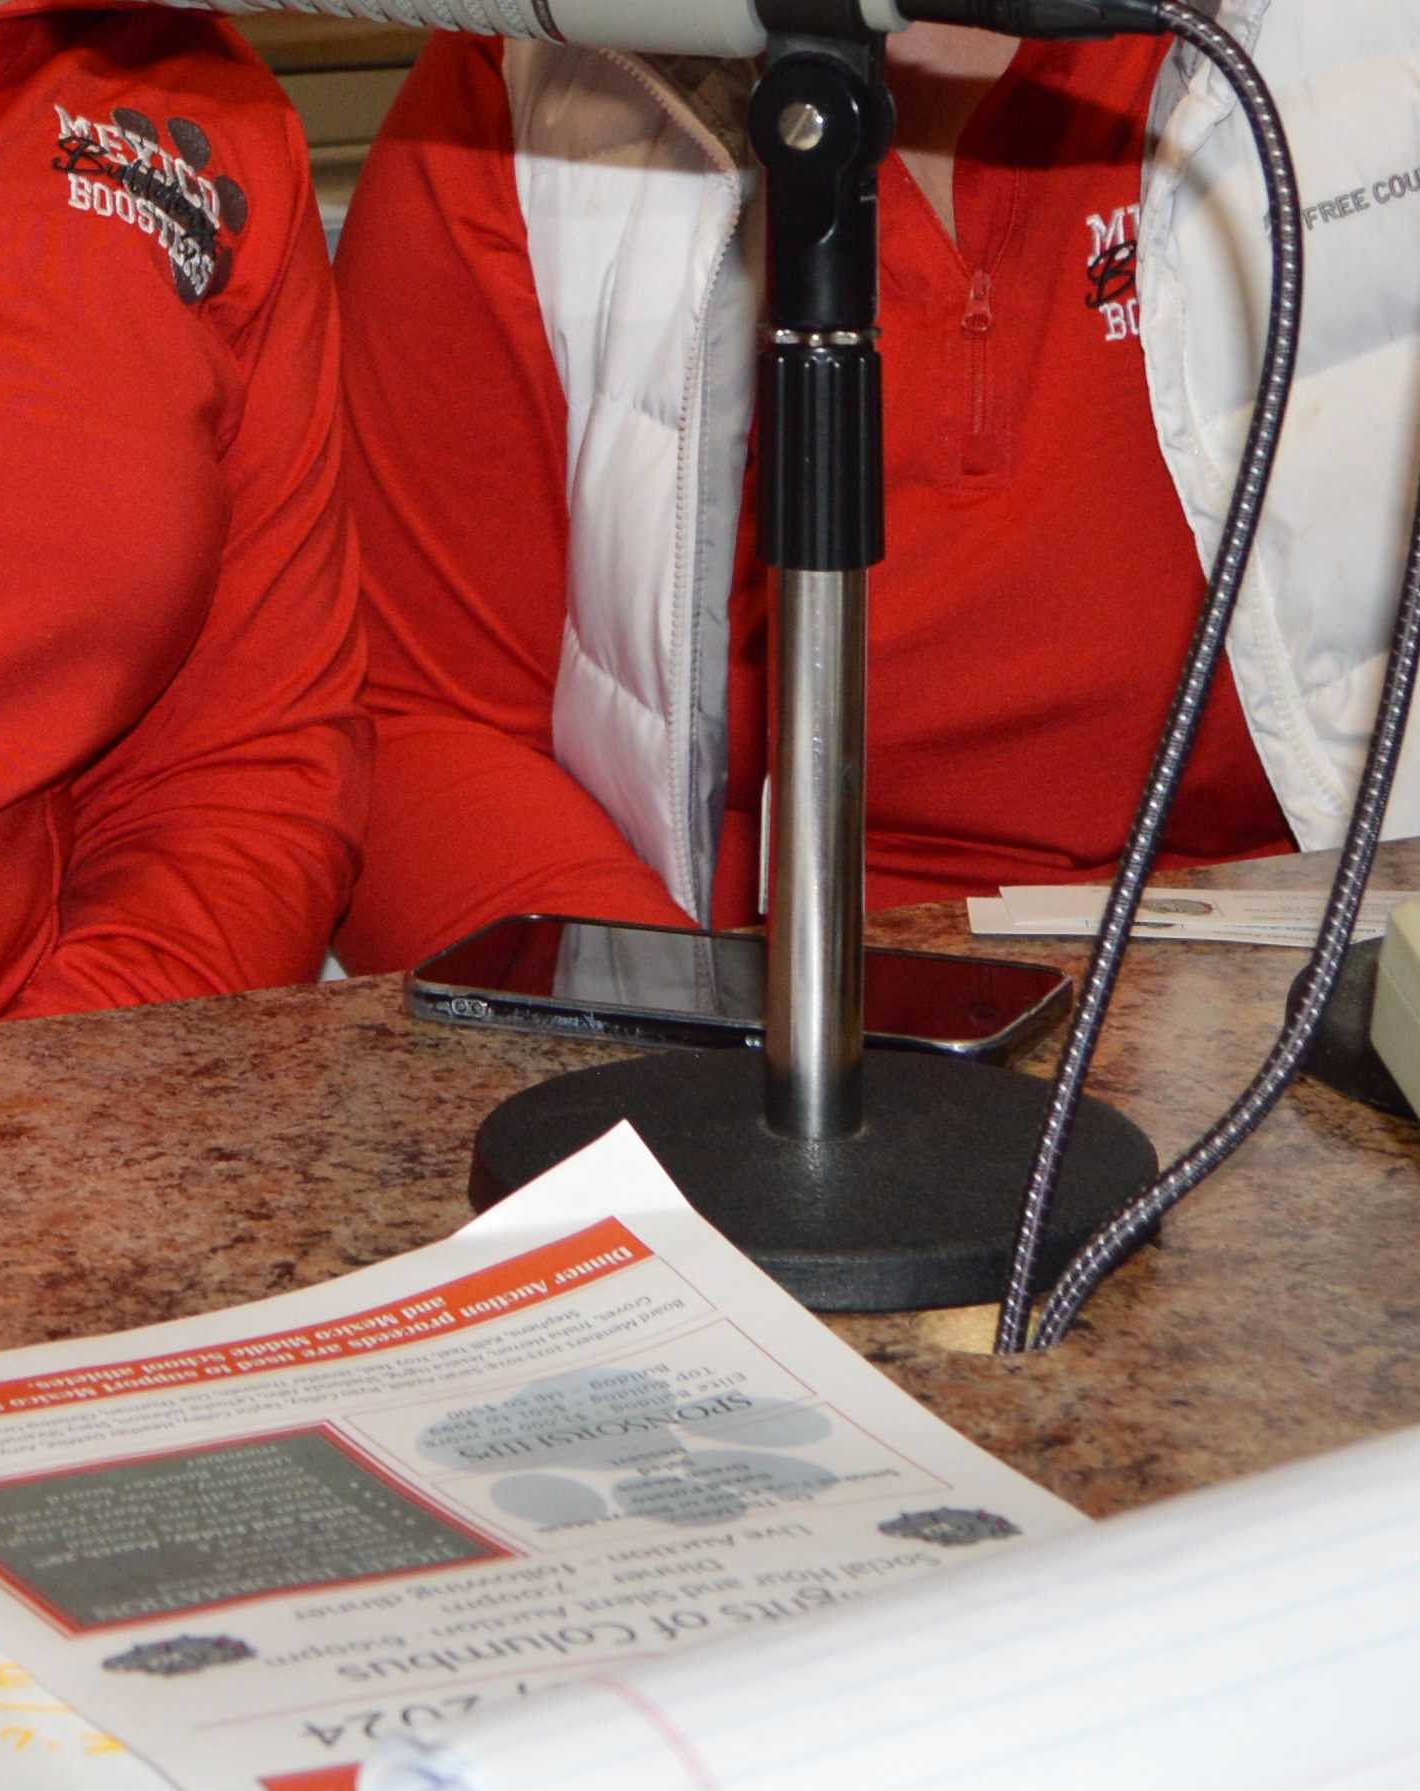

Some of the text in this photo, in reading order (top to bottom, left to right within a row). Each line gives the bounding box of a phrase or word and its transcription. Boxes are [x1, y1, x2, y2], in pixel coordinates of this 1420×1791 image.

[53, 103, 221, 229] MEXICO
[1302, 186, 1369, 230] FREE
[547, 1247, 634, 1282] Dinner
[399, 1297, 448, 1318] and
[457, 1281, 551, 1317] Auction
[592, 1295, 653, 1323] Groves,
[636, 1299, 685, 1320] Board
[313, 1312, 399, 1341] Mexico
[346, 1313, 456, 1349] proceeds
[502, 1309, 581, 1337] Stephens,
[546, 1321, 594, 1339] Trisha
[564, 1317, 636, 1347] Members
[228, 1336, 312, 1357] Middle
[300, 1345, 342, 1356] are
[140, 1352, 227, 1373] School
[201, 1364, 233, 1376] to
[235, 1353, 296, 1370] used
[100, 1368, 200, 1392] support
[587, 1362, 670, 1390] Bulldog
[671, 1365, 714, 1382] Top
[694, 1373, 747, 1392] Elite
[6, 1387, 99, 1407] Mexico
[586, 1378, 670, 1404] Bulldog
[607, 1387, 691, 1412] Bulldog
[444, 1405, 498, 1419] $500
[501, 1398, 530, 1409] to
[425, 1421, 481, 1436] $999
[459, 1394, 751, 1462] SPONSORSHIPS
[483, 1414, 514, 1426] to
[422, 1432, 482, 1447] more
[630, 1485, 703, 1504] Potato
[295, 1523, 811, 1621] Live Auction following dinner
[612, 1559, 720, 1585] Dinner
[839, 1553, 941, 1576] Social
[675, 1578, 749, 1599] and
[753, 1567, 837, 1589] Hour
[577, 1587, 679, 1614] Silent
[433, 1605, 571, 1641] Auction
[643, 1611, 707, 1645] of
[338, 1622, 636, 1683] Columbus
